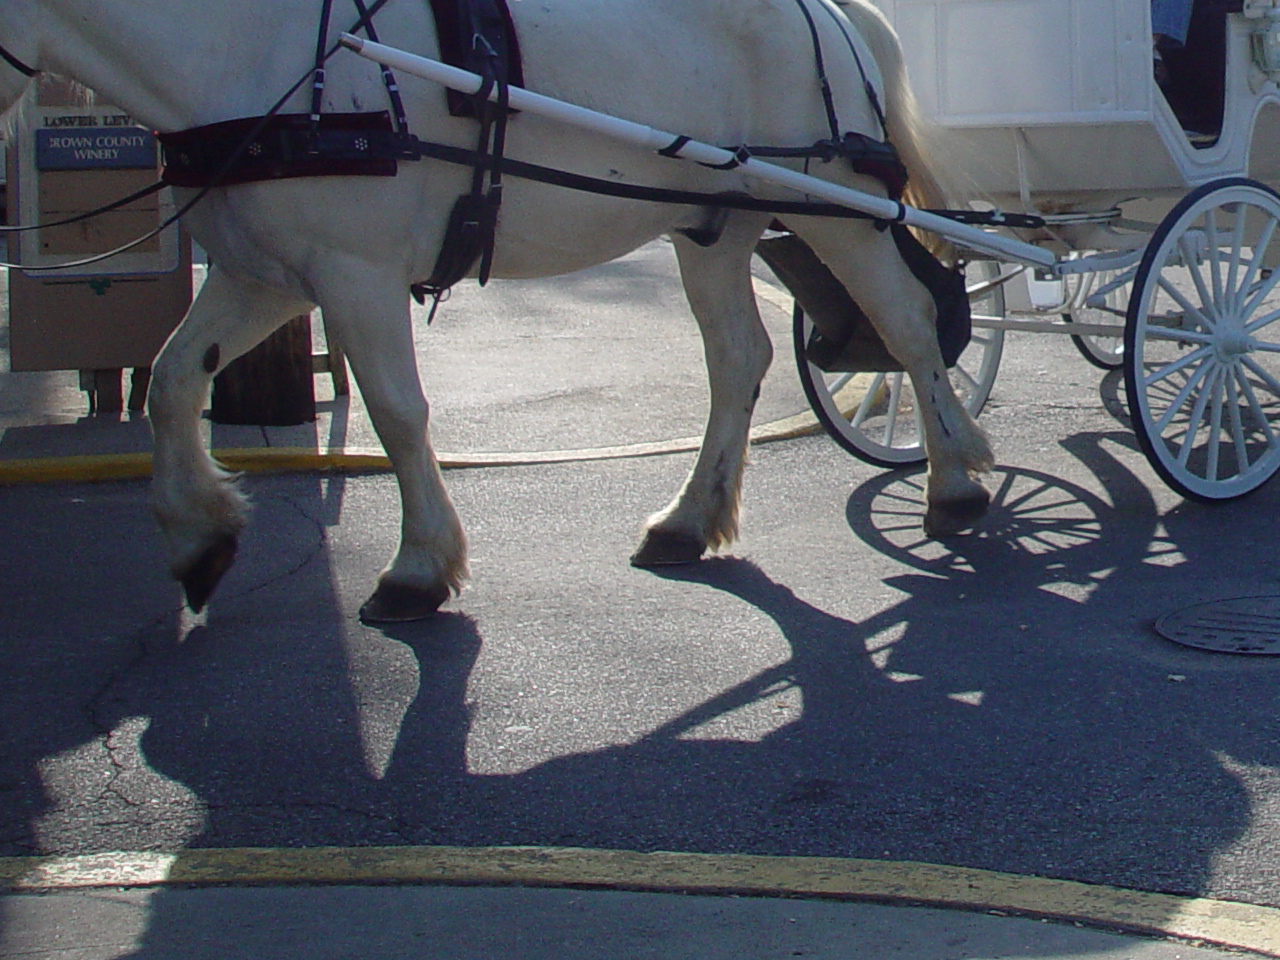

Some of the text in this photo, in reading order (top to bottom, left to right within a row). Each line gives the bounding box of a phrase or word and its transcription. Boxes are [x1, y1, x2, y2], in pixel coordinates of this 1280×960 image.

[43, 115, 136, 127] LOWER LEV
[49, 135, 146, 148] BROWN COUNTY
[74, 148, 120, 160] WINERY
